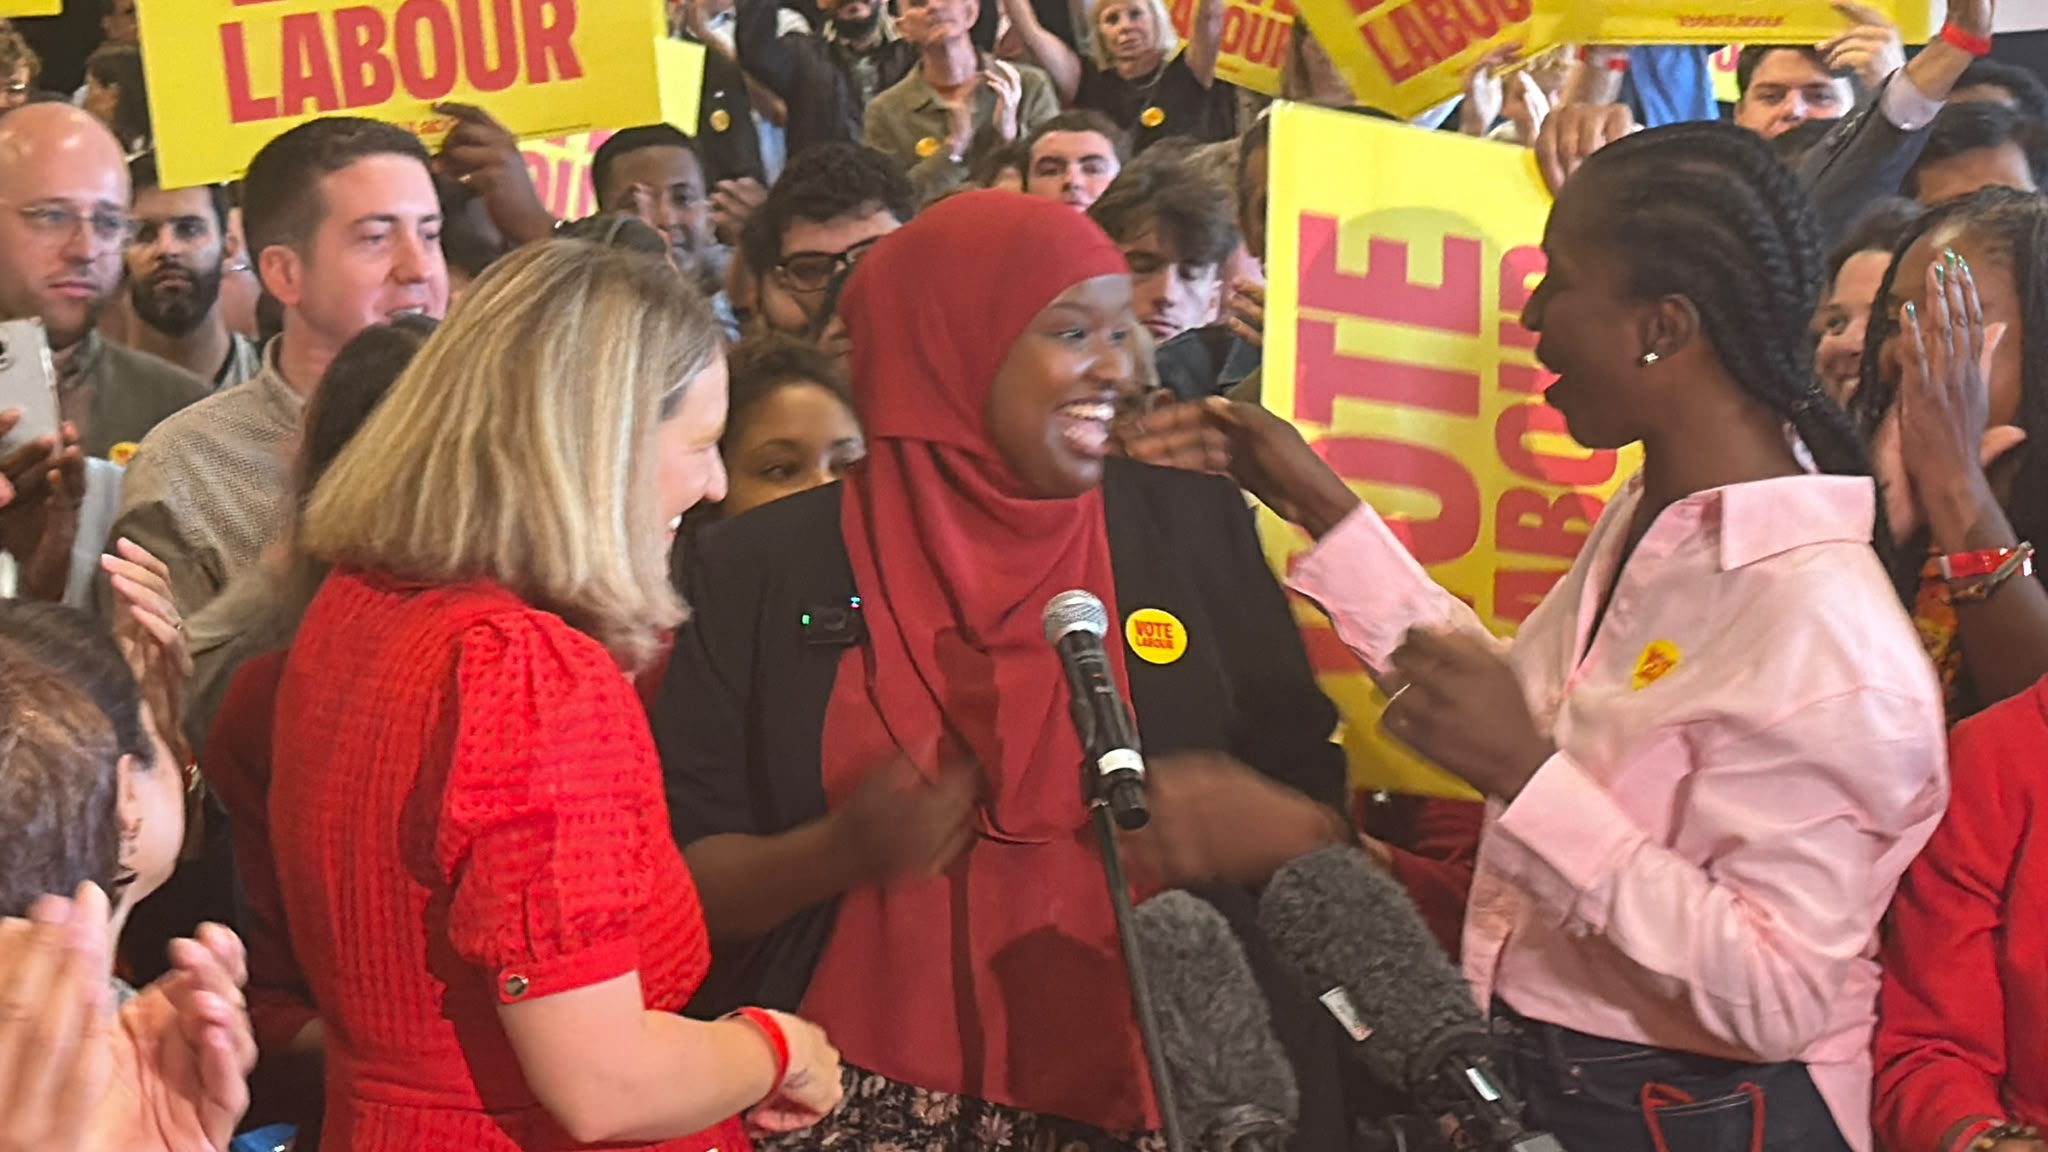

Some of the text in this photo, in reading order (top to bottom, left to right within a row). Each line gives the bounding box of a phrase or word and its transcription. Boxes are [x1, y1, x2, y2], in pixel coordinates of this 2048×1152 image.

[219, 0, 583, 124] LABOUR
[1286, 210, 1482, 674] OTE
[1135, 620, 1173, 638] VOTE
